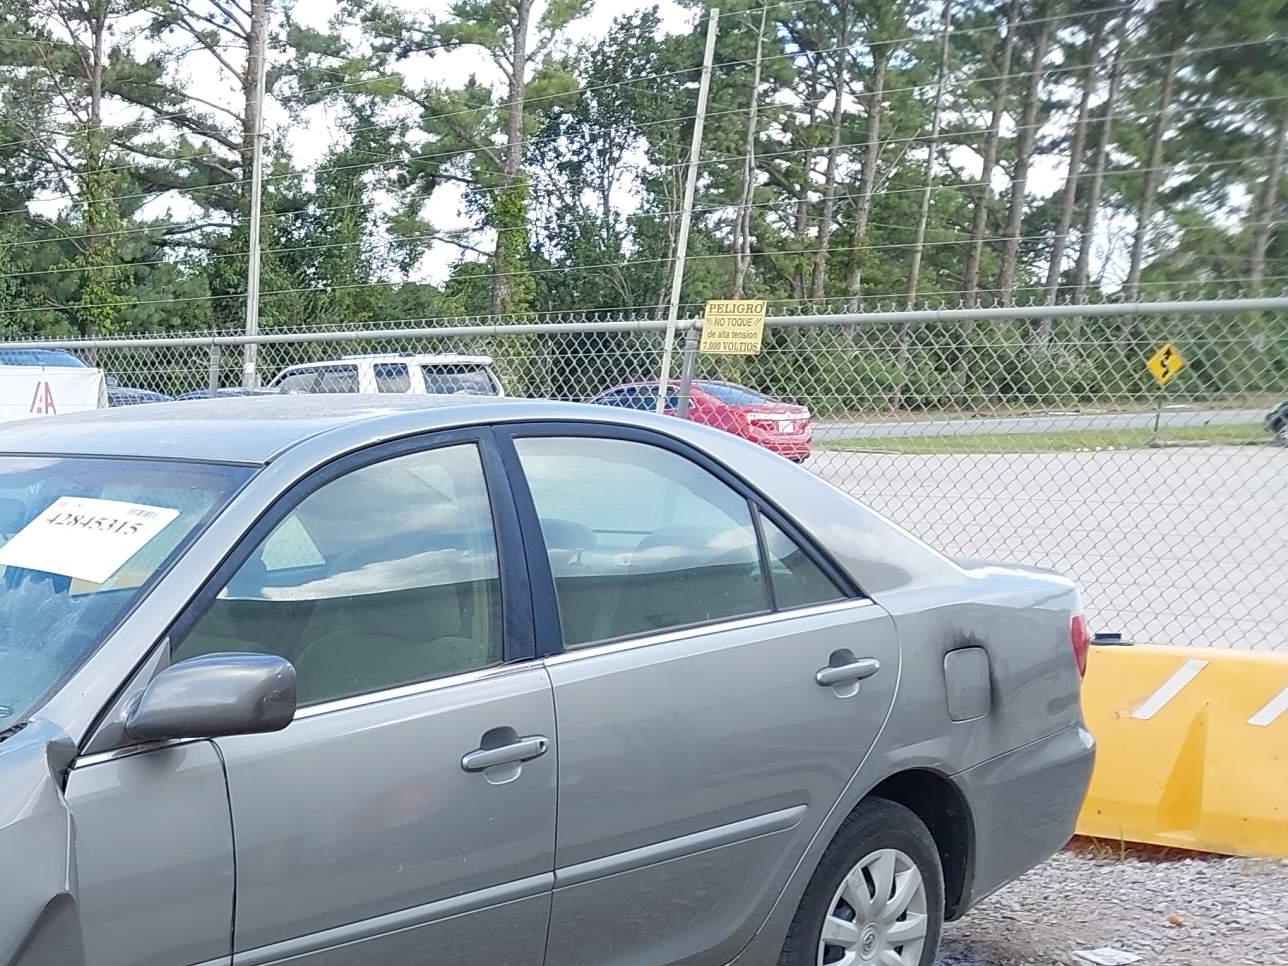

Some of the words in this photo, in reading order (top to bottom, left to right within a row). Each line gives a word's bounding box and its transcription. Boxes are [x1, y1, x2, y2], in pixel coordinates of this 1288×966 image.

[708, 303, 763, 314] PELIGRO
[714, 317, 725, 326] NO
[727, 317, 753, 326] TOQUE
[707, 330, 716, 339] de
[717, 330, 730, 339] alta
[723, 342, 758, 353] VOLTIOS
[46, 512, 144, 535] 42845315
